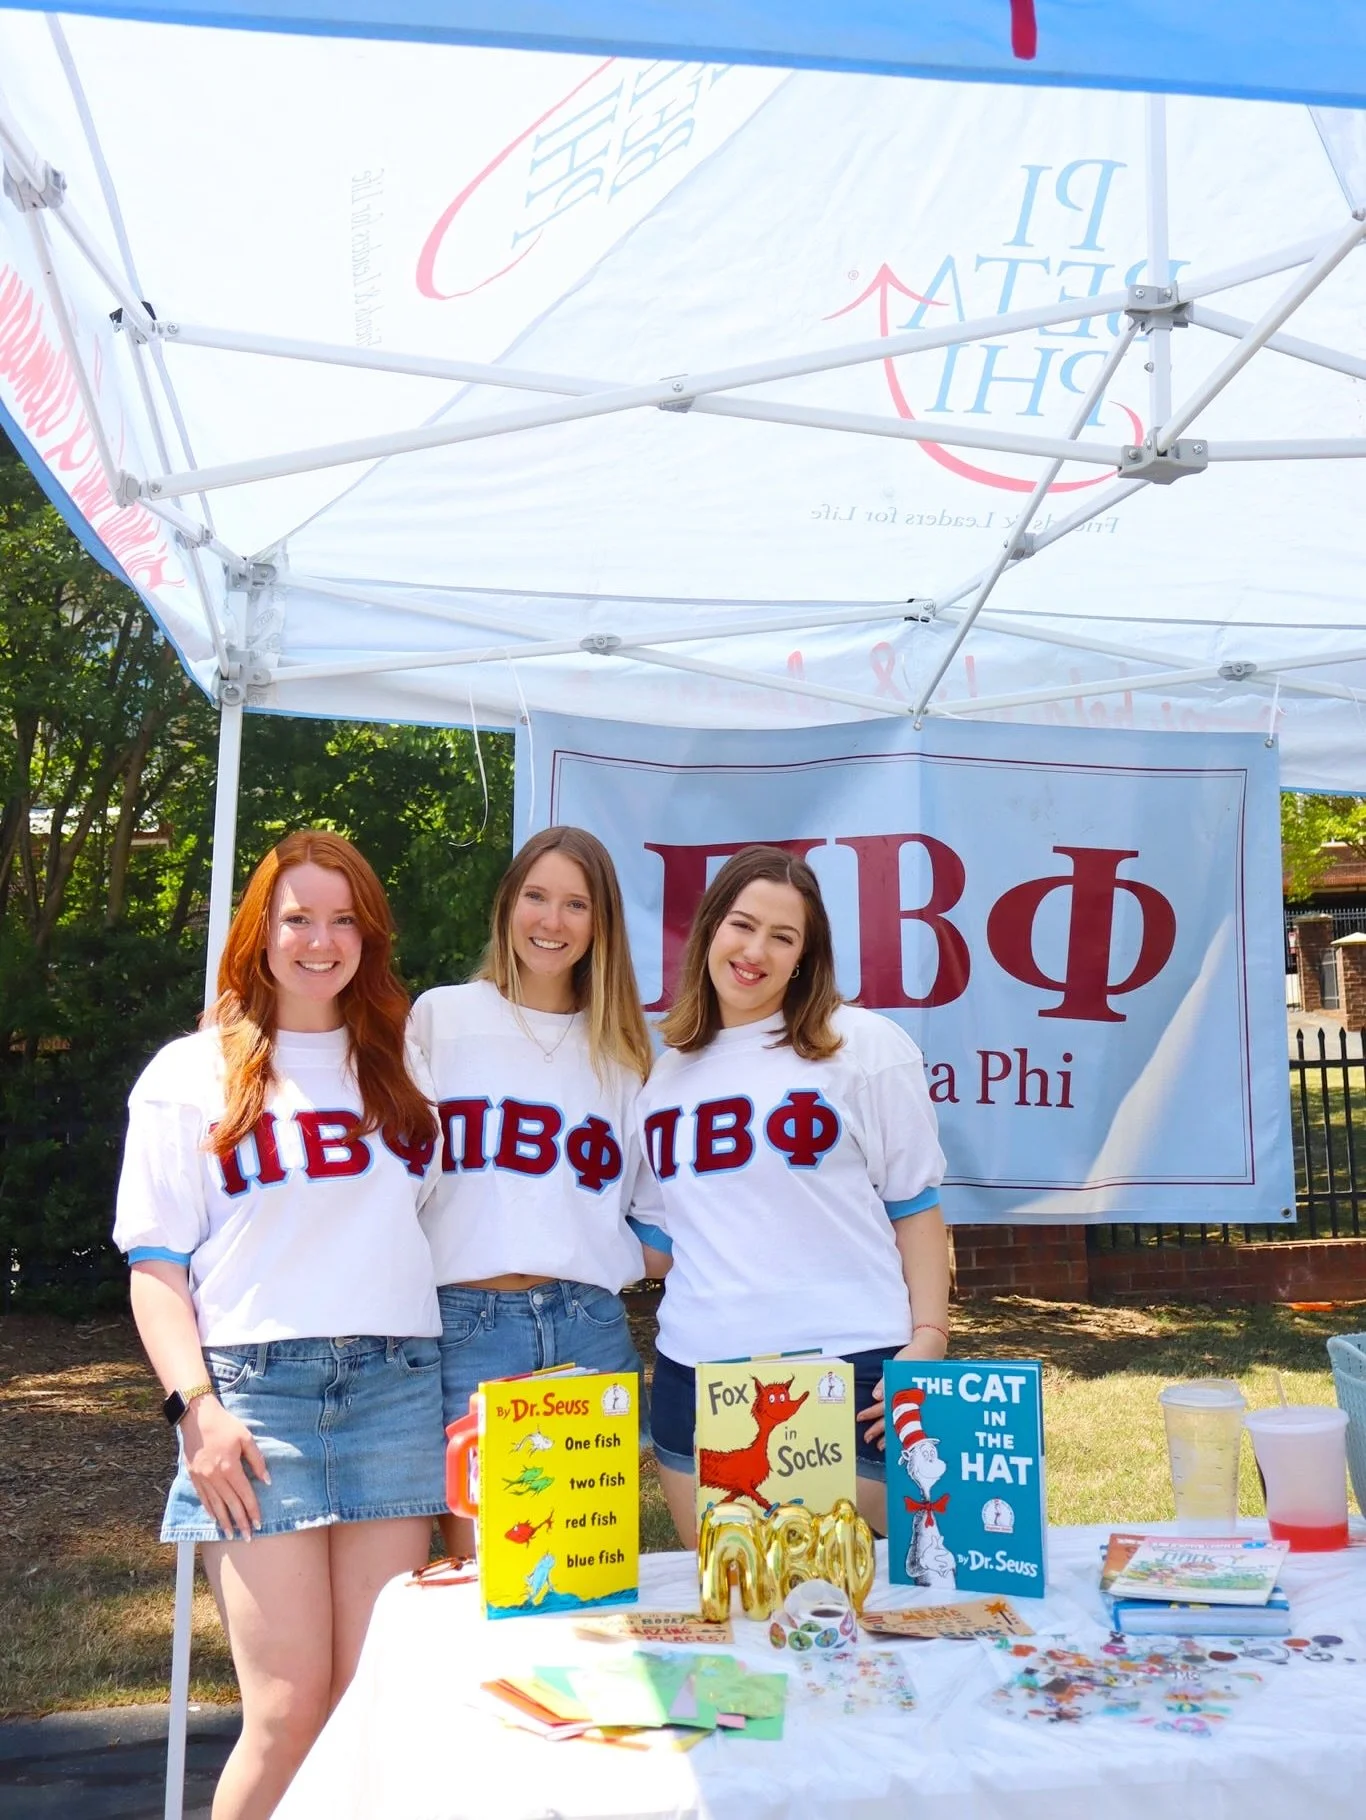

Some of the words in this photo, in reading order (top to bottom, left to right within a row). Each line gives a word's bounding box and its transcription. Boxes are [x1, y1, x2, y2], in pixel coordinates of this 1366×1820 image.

[976, 1047, 1075, 1109] Phi
[708, 1381, 749, 1416] Fox
[911, 1376, 954, 1396] THE
[958, 1372, 1027, 1404] CAT
[496, 1406, 511, 1420] By
[511, 1399, 541, 1422] Dr.
[543, 1392, 590, 1417] Seuss
[983, 1410, 1006, 1427] IN
[565, 1436, 591, 1451] One
[594, 1433, 622, 1448] fish
[784, 1426, 798, 1441] in
[974, 1431, 1014, 1450] THE
[776, 1437, 843, 1478] Socks
[961, 1452, 1033, 1486] HAT
[569, 1477, 596, 1490] two
[599, 1472, 625, 1487] fish
[565, 1513, 587, 1529] red
[591, 1511, 618, 1527] fish
[567, 1554, 595, 1569] blue
[598, 1548, 625, 1565] fish
[957, 1554, 969, 1566] By
[968, 1550, 994, 1571] Dr.
[995, 1550, 1038, 1578] Seuss
